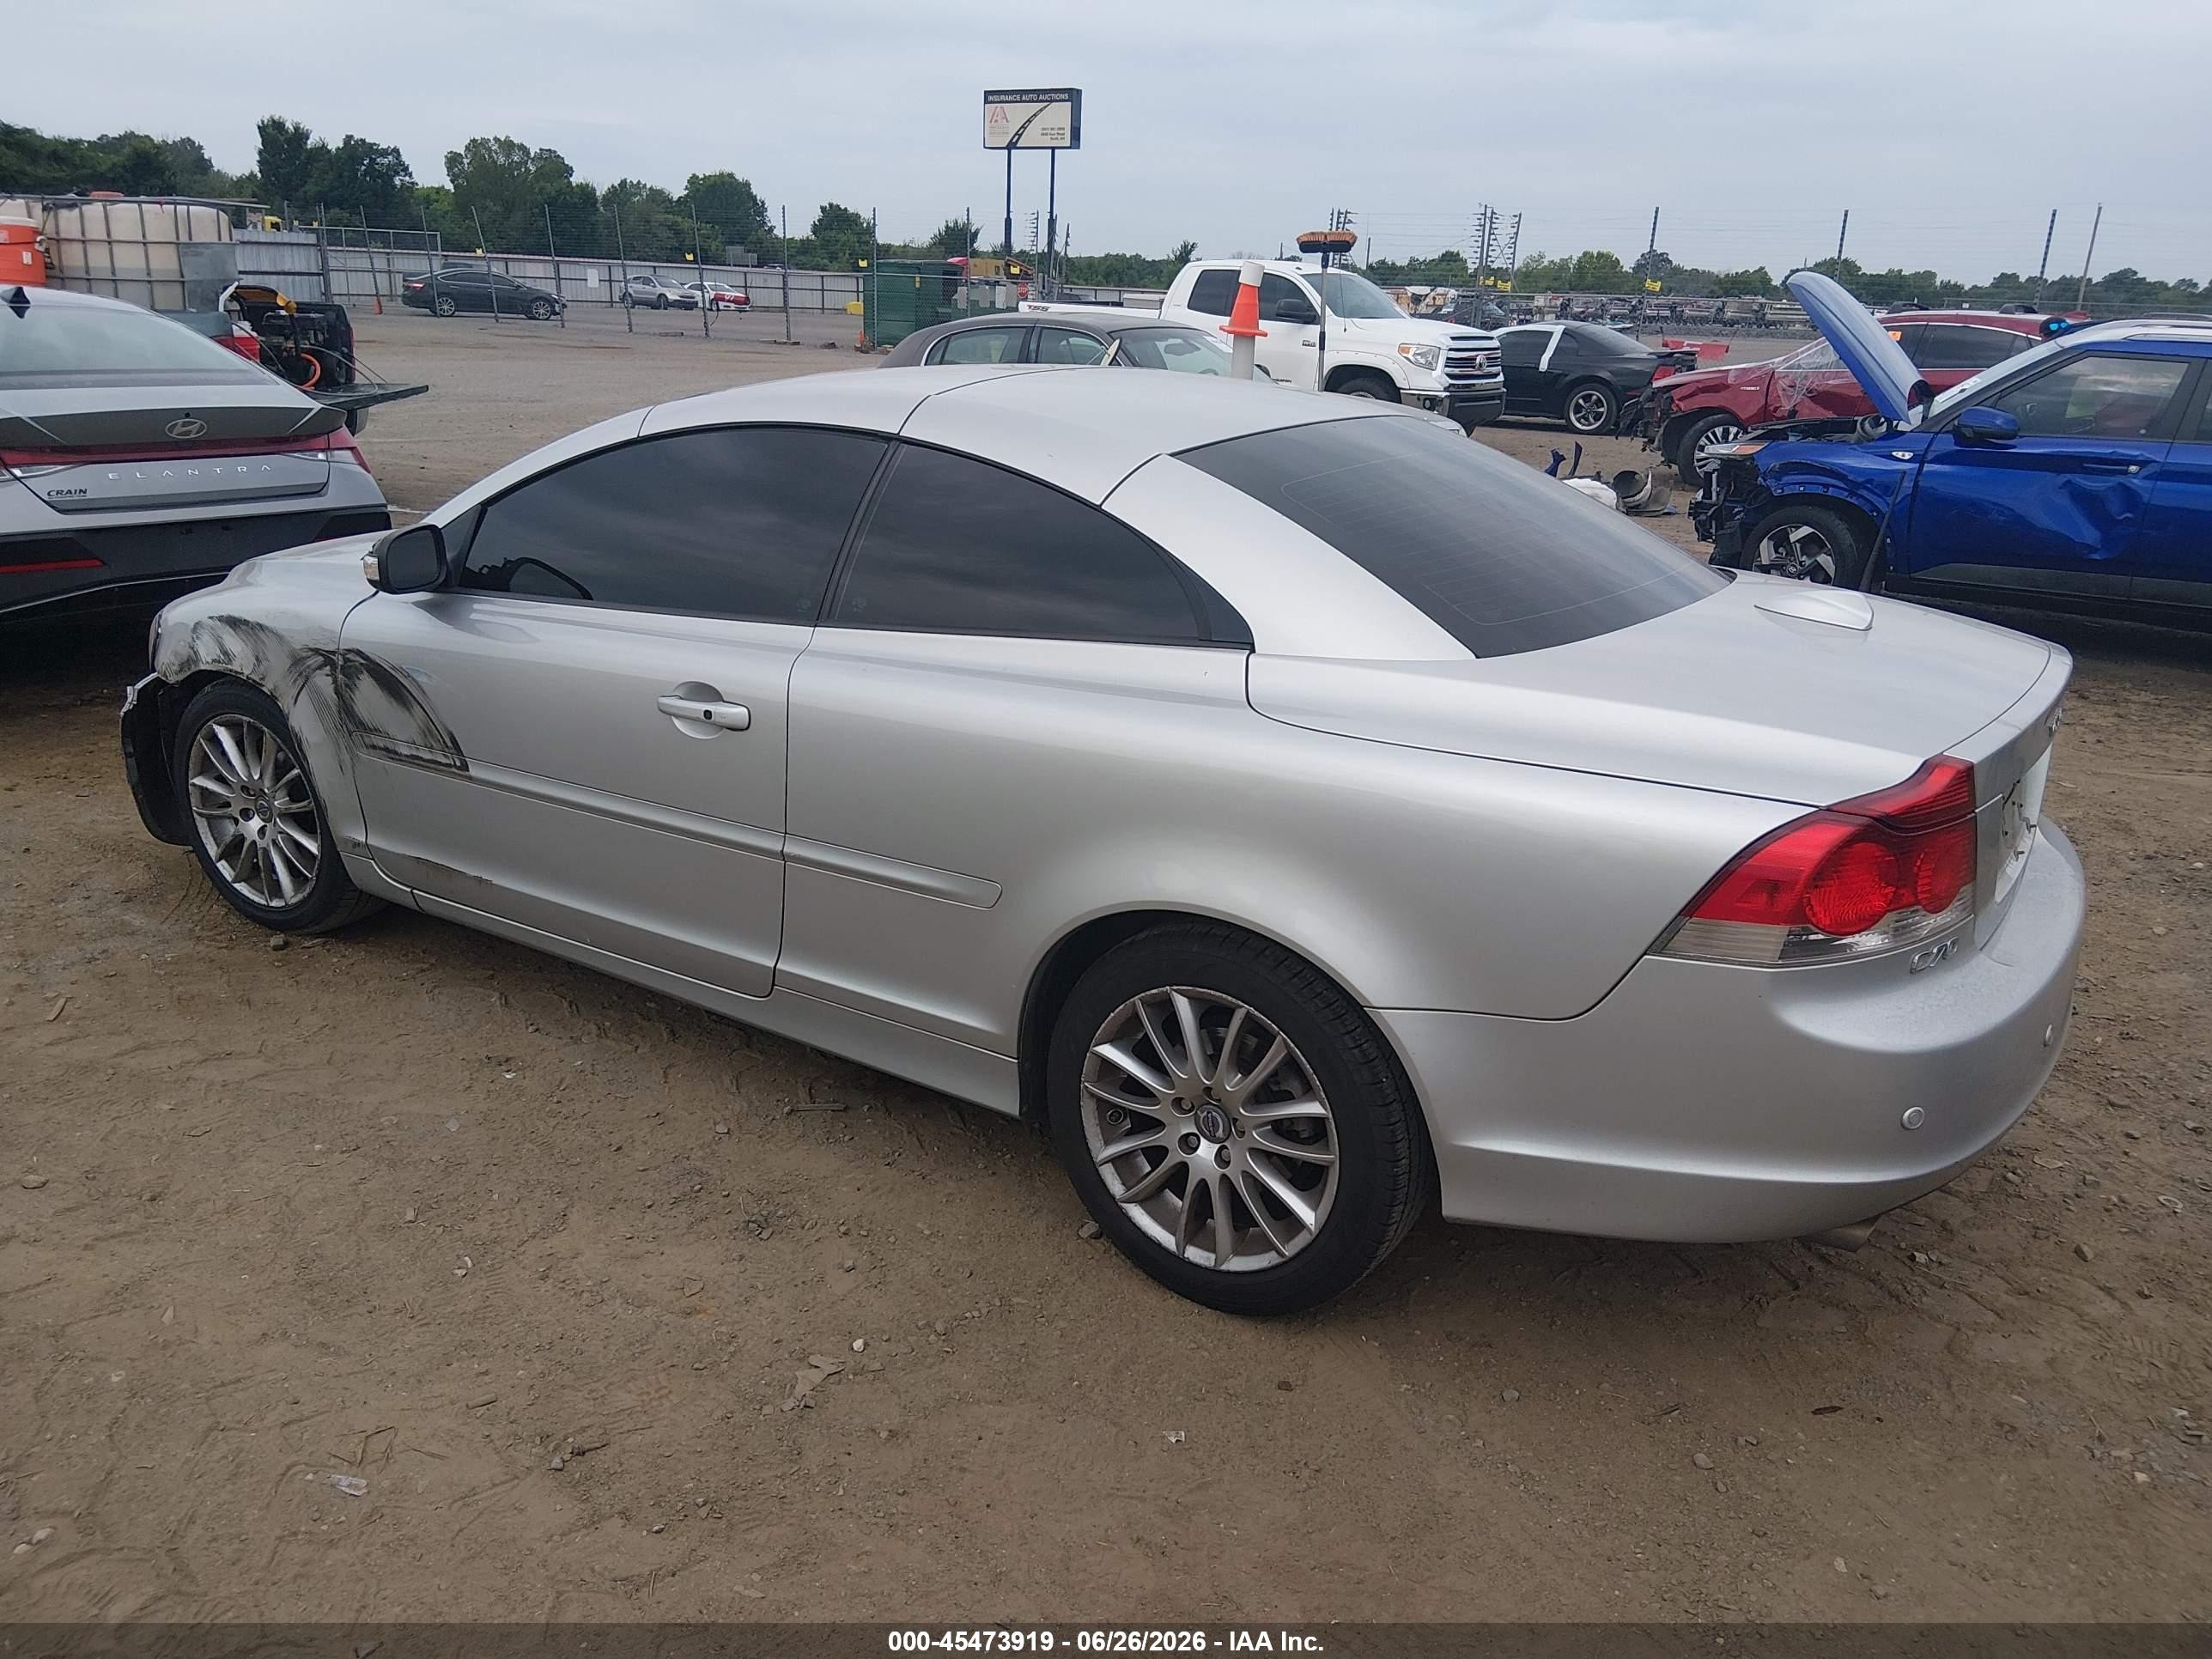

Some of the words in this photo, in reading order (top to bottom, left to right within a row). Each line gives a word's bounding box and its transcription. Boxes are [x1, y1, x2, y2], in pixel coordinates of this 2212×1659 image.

[108, 465, 270, 480] ELANTRA
[46, 488, 88, 497] CRAIN
[1910, 935, 1959, 975] C70
